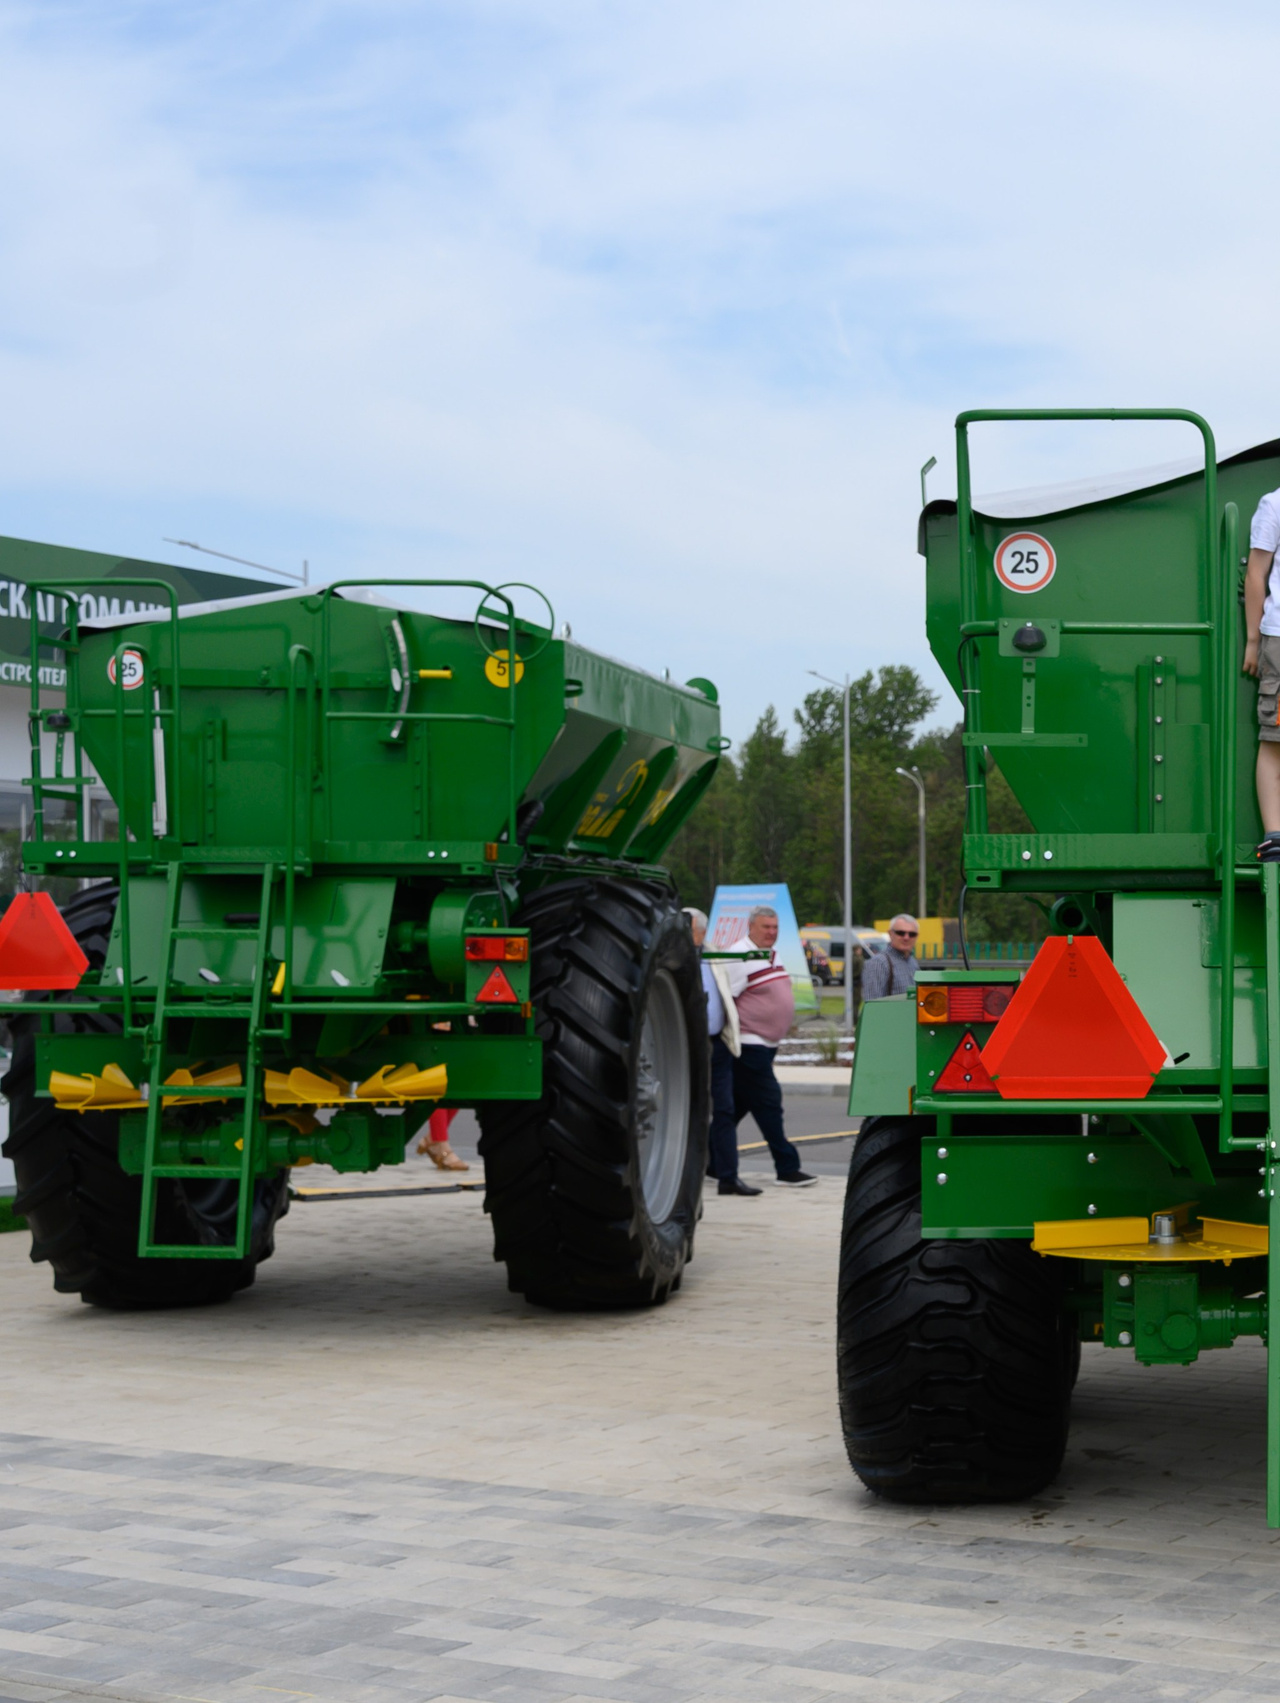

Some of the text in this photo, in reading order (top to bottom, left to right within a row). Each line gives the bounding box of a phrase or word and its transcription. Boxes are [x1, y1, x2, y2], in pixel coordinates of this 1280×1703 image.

[1010, 551, 1039, 574] 25
[0, 580, 165, 625] СКАГРОМ
[0, 662, 67, 687] СТРОИТЕЛ
